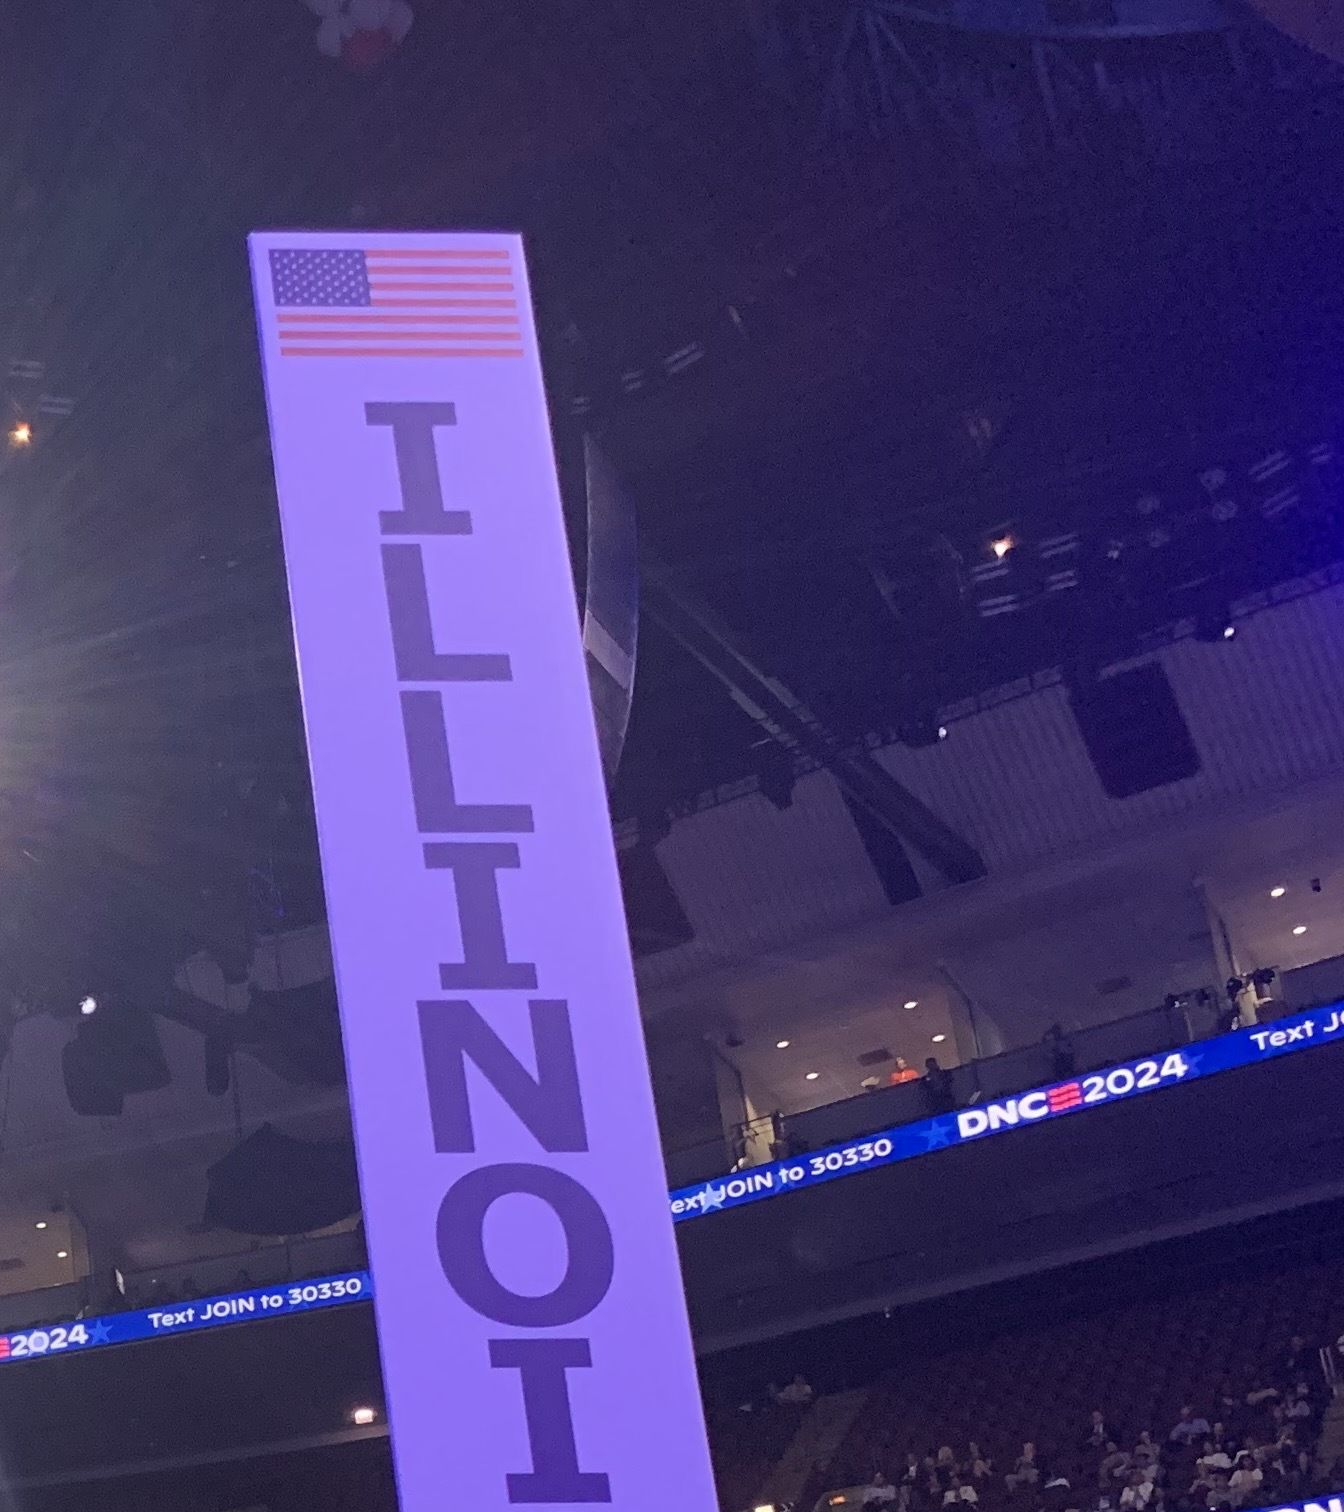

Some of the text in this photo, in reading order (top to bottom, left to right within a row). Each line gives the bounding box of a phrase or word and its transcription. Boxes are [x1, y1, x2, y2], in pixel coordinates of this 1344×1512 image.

[1249, 1020, 1314, 1051] Text
[958, 1053, 1188, 1138] DNC 2024
[671, 1138, 893, 1214] ext JOIN to 30330
[10, 1278, 362, 1357] 2024 Text JOIN to 30330
